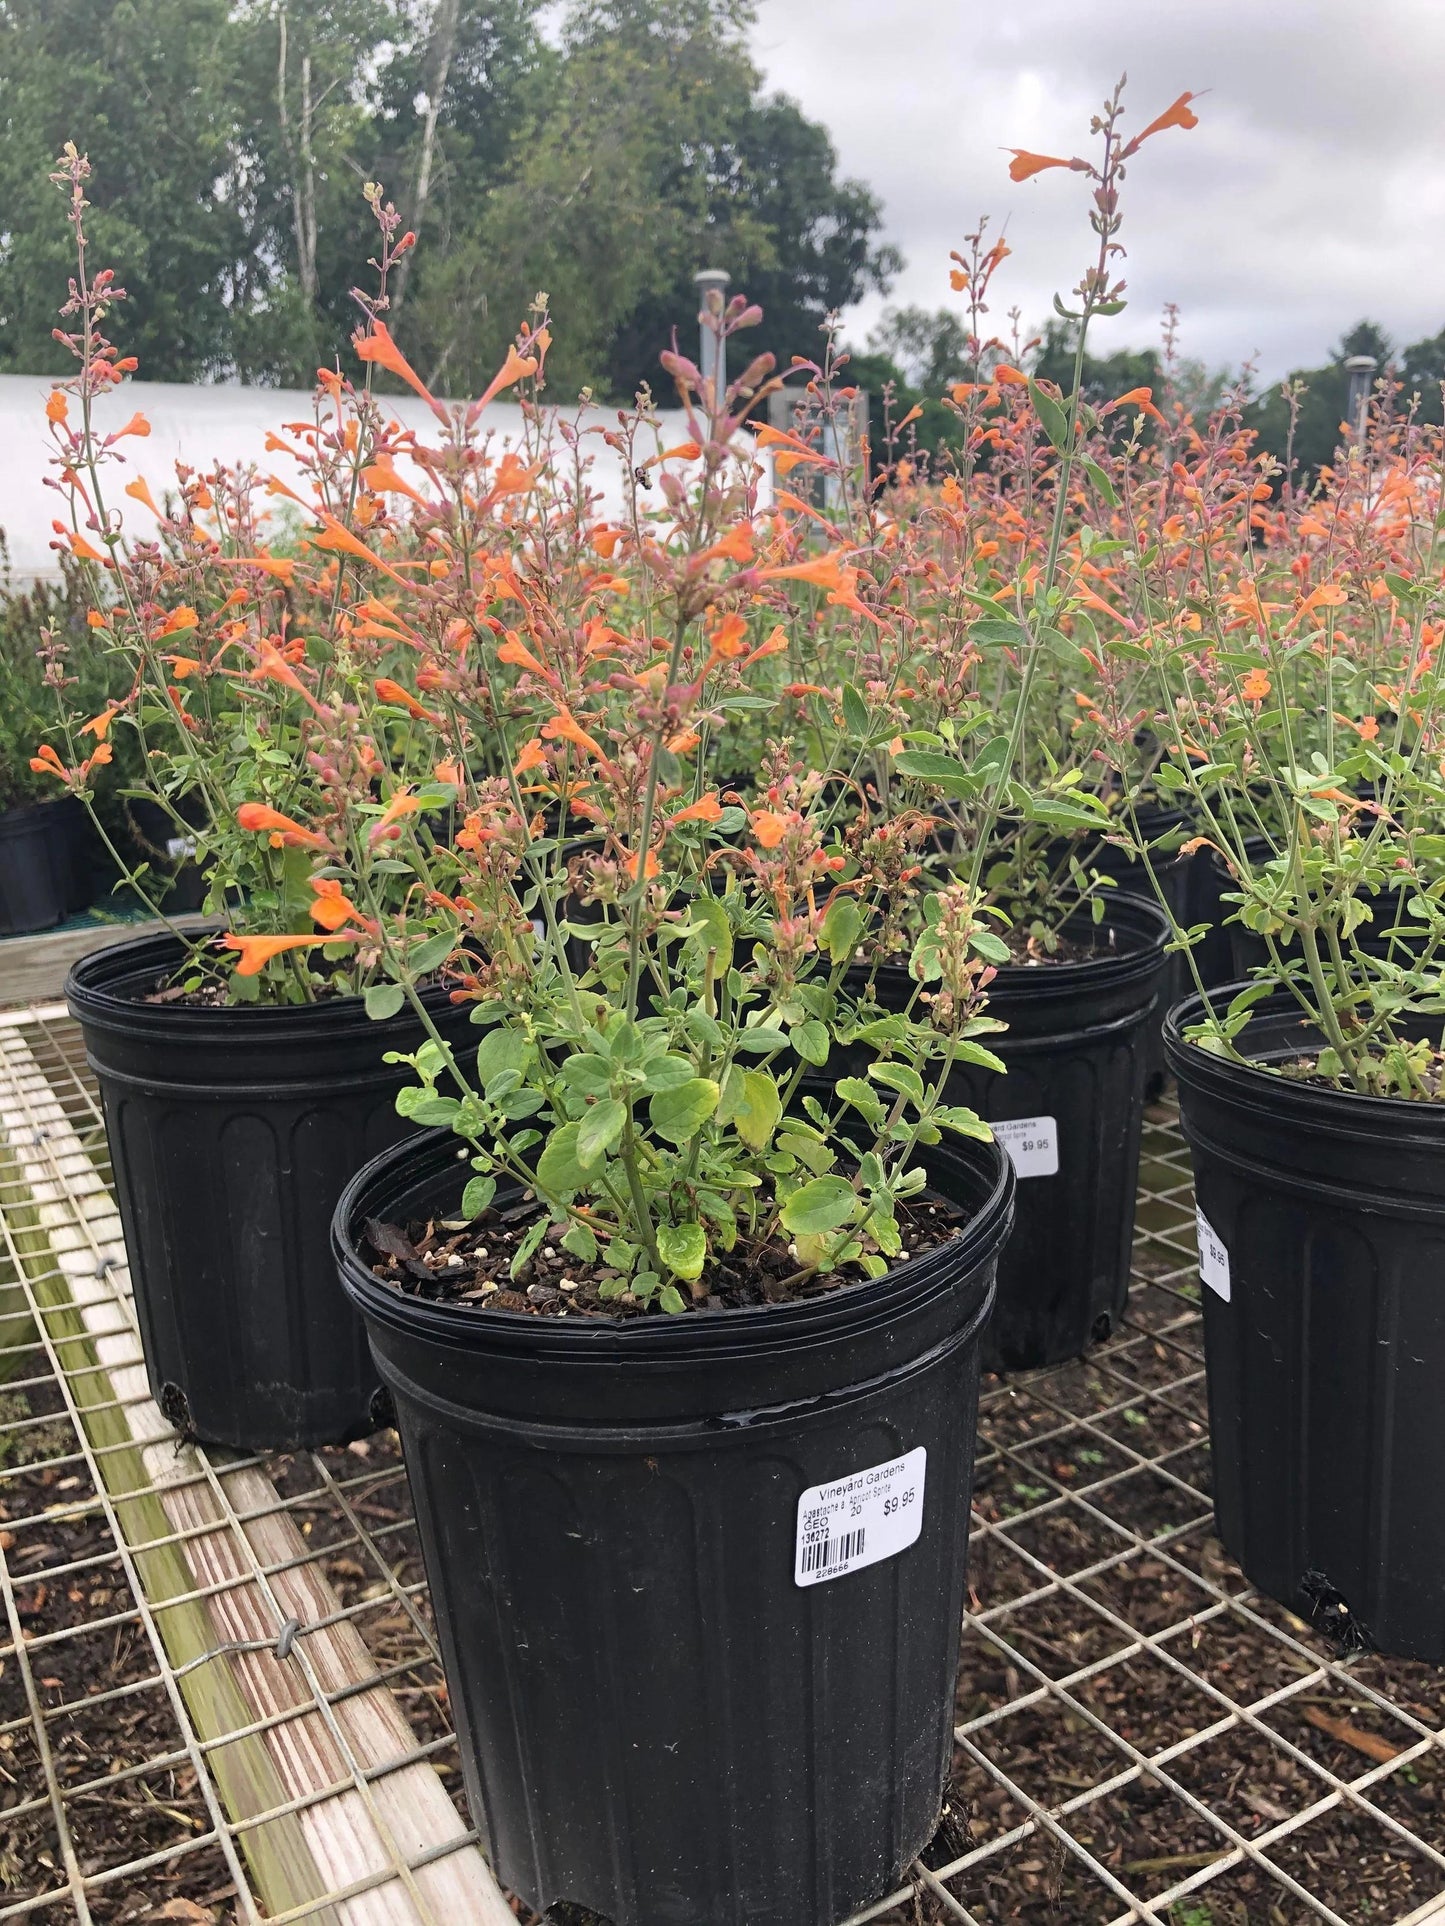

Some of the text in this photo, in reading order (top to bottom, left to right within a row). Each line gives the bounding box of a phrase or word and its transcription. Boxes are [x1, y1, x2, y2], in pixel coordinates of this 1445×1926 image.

[1022, 1139, 1048, 1151] $9.95
[819, 1462, 905, 1501] Vineyard Gardens
[803, 1503, 839, 1519] Agastache
[849, 1489, 872, 1505] Apricot
[873, 1483, 892, 1498] Sprite
[883, 1487, 916, 1517] $9.95
[803, 1505, 862, 1532] GEO 20
[816, 1561, 849, 1579] 228666
